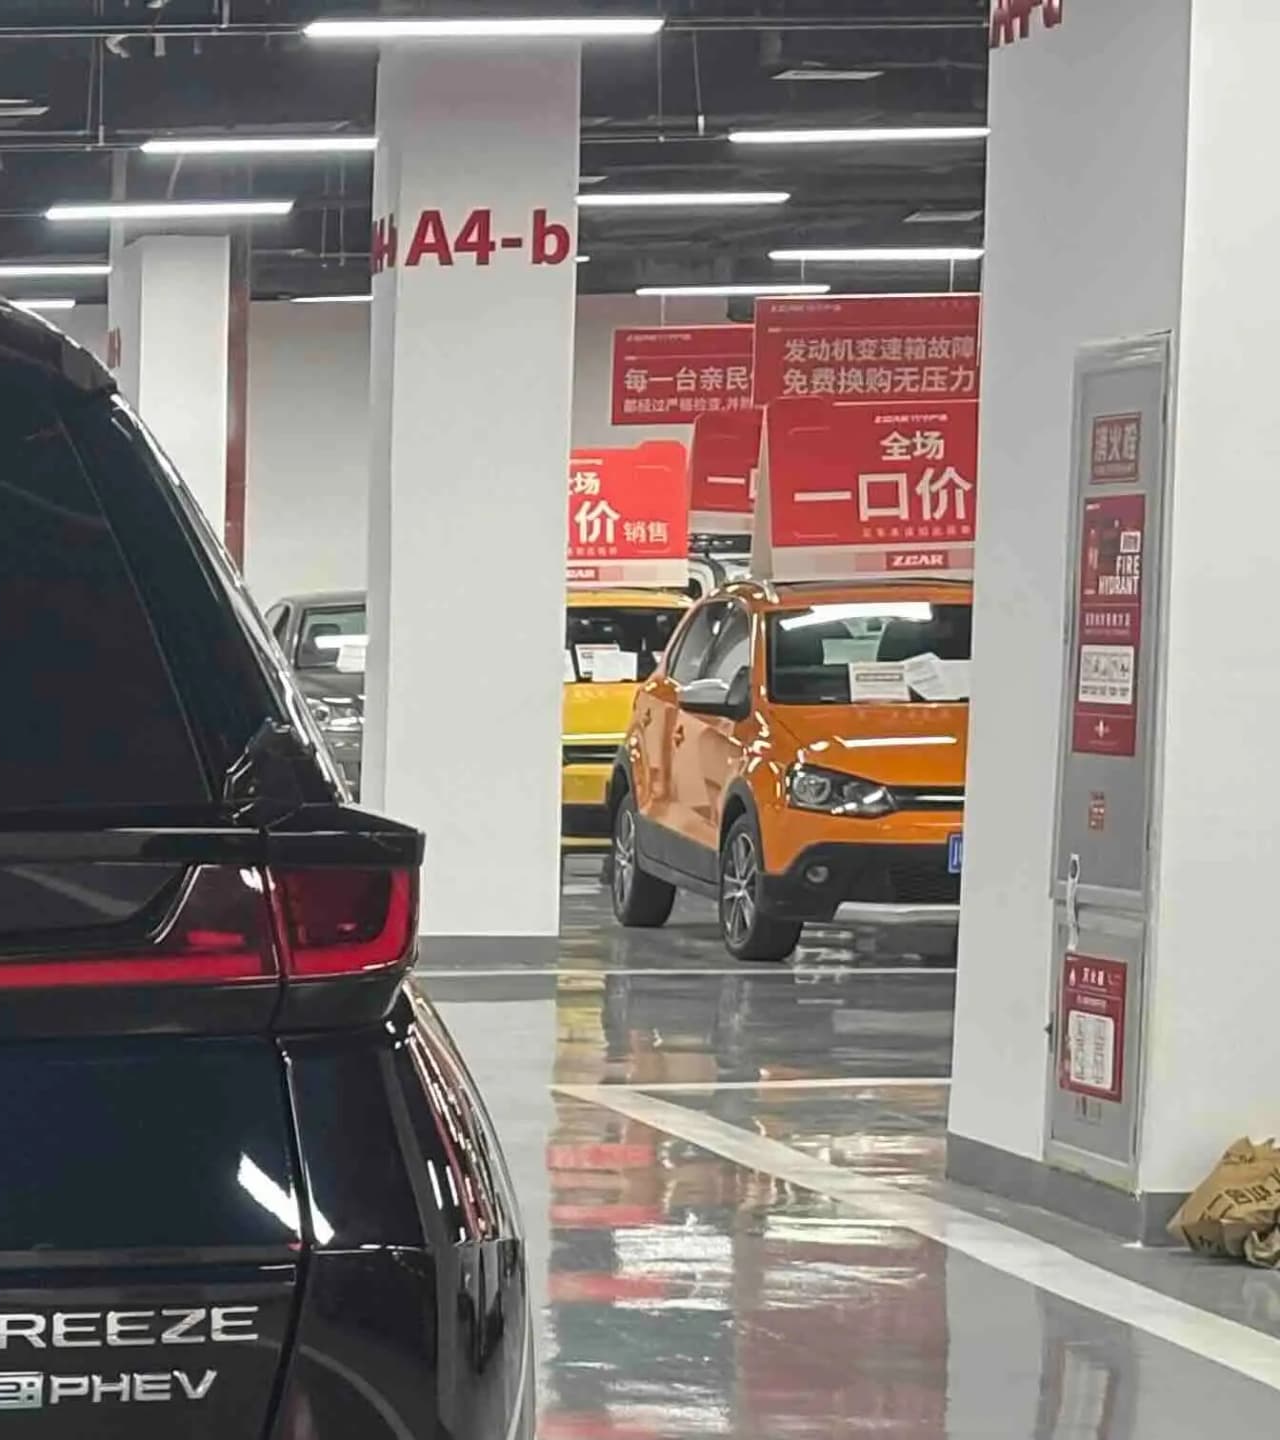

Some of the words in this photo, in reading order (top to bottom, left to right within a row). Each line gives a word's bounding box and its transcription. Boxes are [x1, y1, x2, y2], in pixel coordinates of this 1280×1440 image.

[404, 208, 570, 266] A4-b
[784, 336, 975, 362] 发动机变速箱故障
[624, 366, 753, 392] 每一台亲民
[782, 366, 975, 395] 免费换购无压力
[880, 430, 945, 461] 全场
[794, 466, 973, 522] 一口价
[574, 500, 621, 544] 价
[623, 521, 670, 544] 销售
[892, 554, 944, 567] ZCAR
[1117, 554, 1140, 576] FIRE
